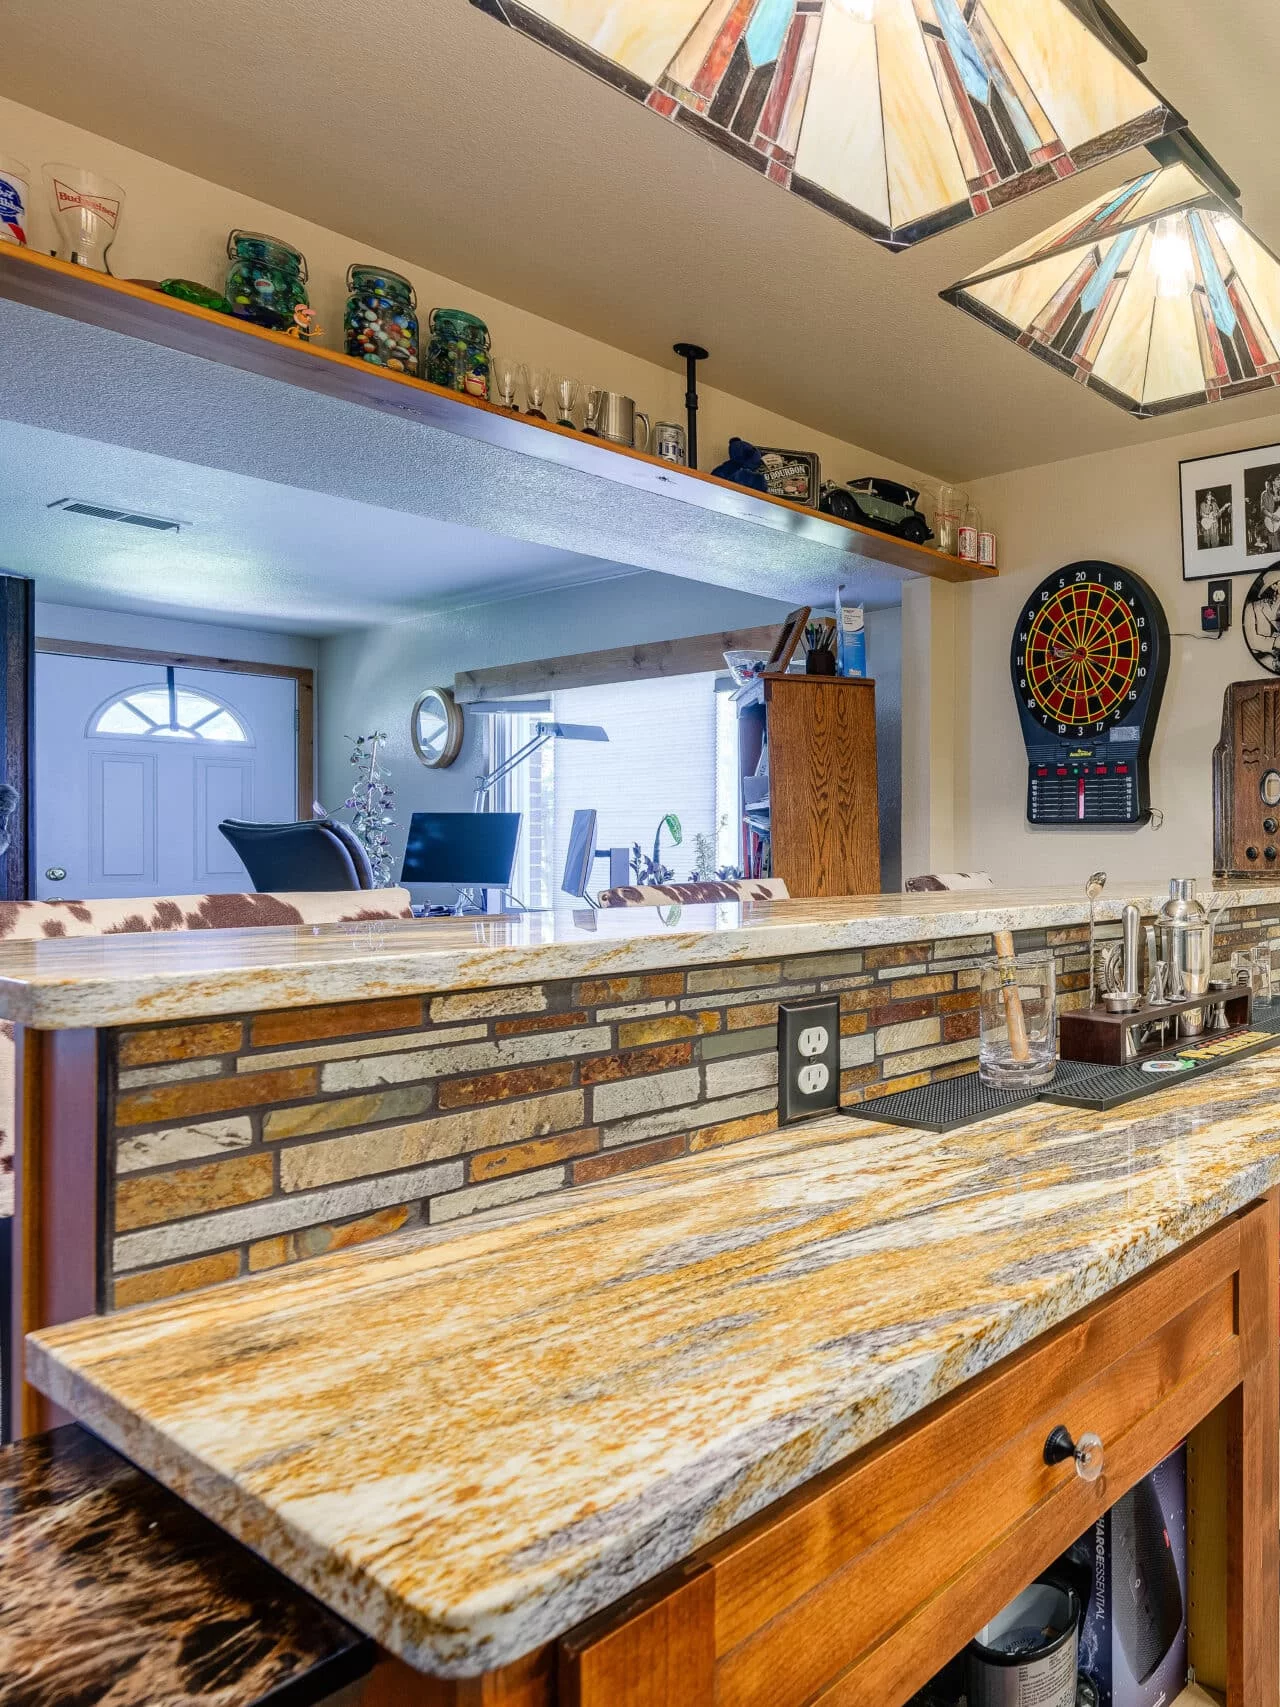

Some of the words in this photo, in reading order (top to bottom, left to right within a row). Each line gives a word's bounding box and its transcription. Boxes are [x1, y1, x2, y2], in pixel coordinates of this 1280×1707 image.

[58, 191, 117, 218] Budweiser
[769, 465, 806, 480] BOURBON
[1075, 571, 1087, 582] 20
[1097, 573, 1102, 583] 1
[1059, 578, 1064, 588] 5
[1113, 581, 1122, 591] 18
[1041, 592, 1049, 601] 12
[1129, 598, 1135, 607] 4
[1028, 611, 1034, 621] 9
[1136, 618, 1145, 627] 13
[1019, 633, 1027, 642] 14
[1141, 642, 1148, 652] 6
[1017, 656, 1024, 665] 11
[1137, 667, 1146, 677] 10
[1020, 679, 1026, 688] 8
[1128, 691, 1137, 700] 15
[1027, 699, 1036, 708] 16
[1042, 715, 1048, 724] 7
[1114, 710, 1120, 720] 2
[1058, 724, 1067, 733] 19
[1077, 726, 1084, 736] 3
[1096, 722, 1104, 731] 17
